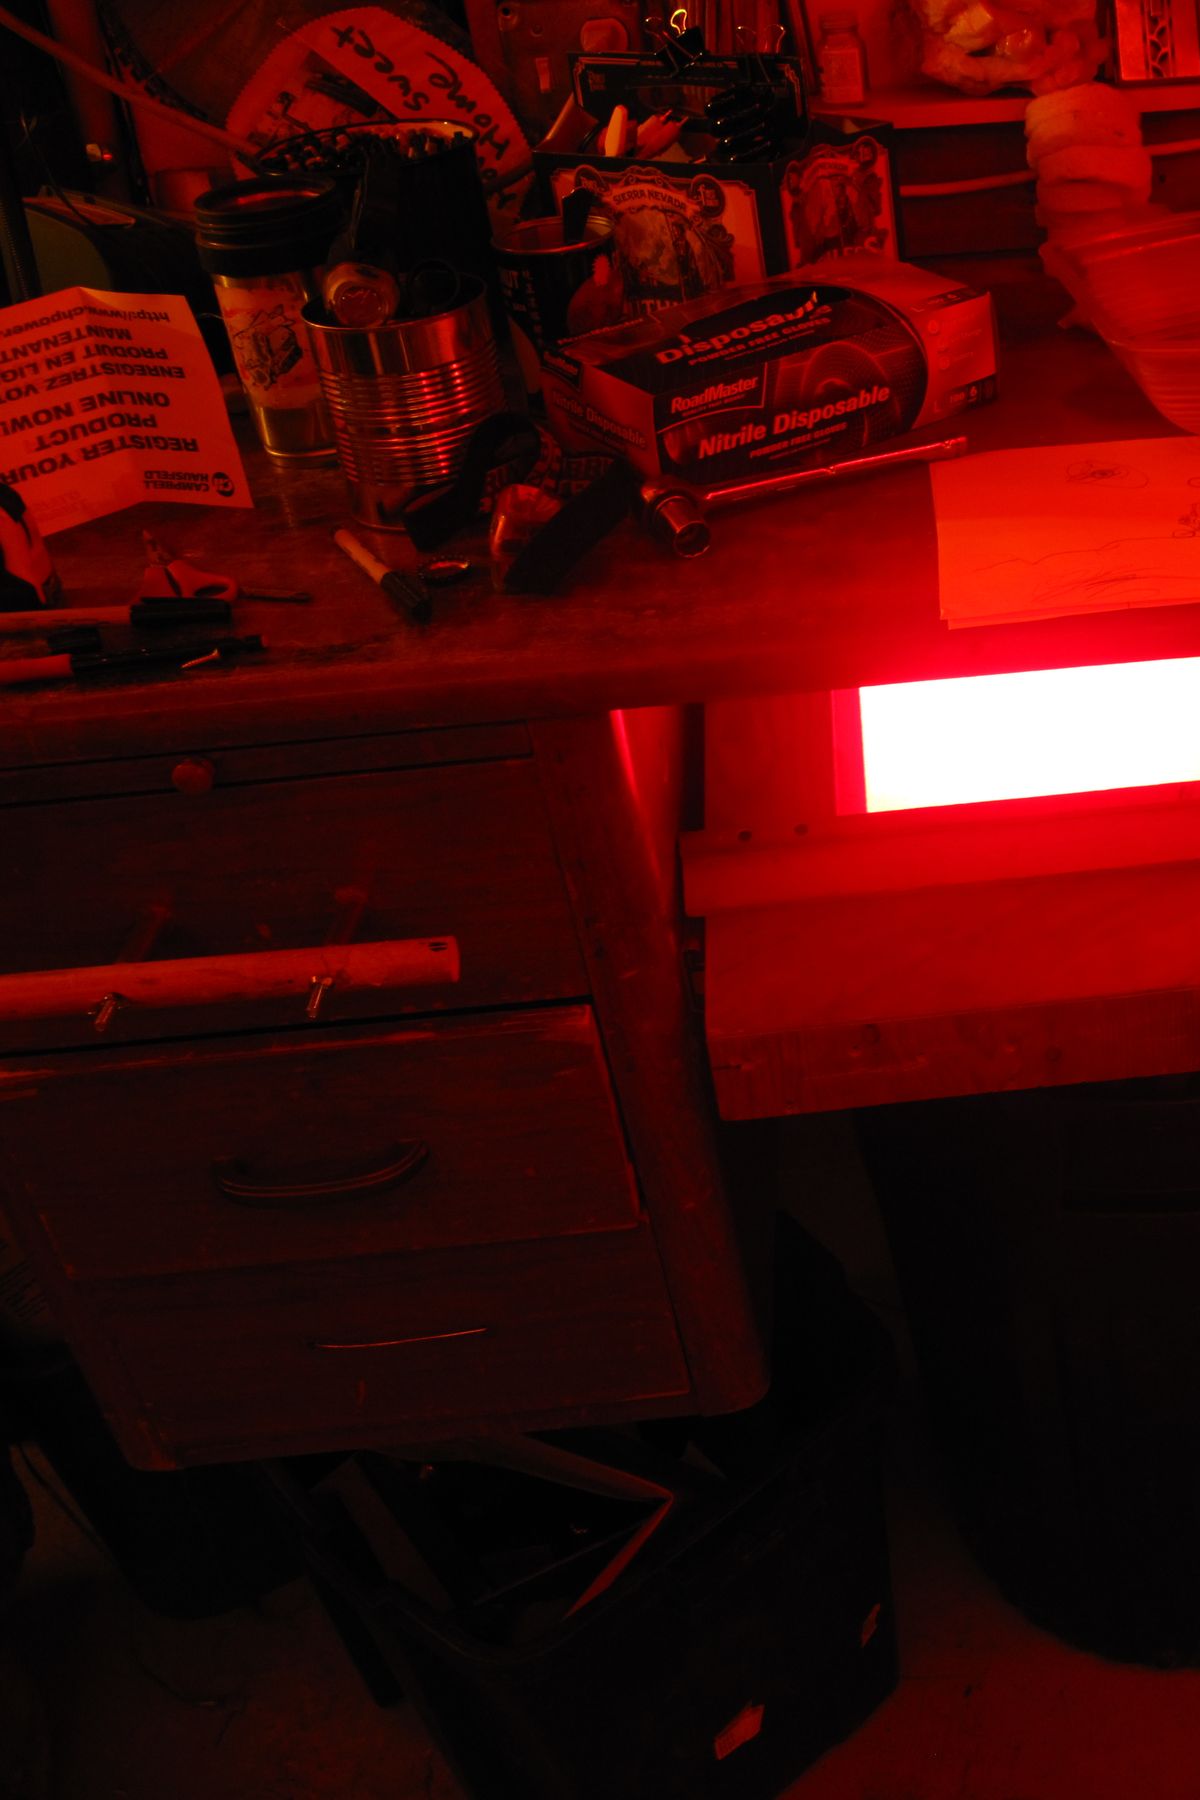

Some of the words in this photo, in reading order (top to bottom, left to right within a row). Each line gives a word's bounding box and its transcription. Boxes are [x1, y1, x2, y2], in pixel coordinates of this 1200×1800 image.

[612, 190, 648, 206] SIERRA
[647, 190, 687, 210] NEVADA
[655, 290, 832, 365] Disposae
[46, 351, 75, 370] EN
[83, 345, 168, 359] PRODUIT
[47, 362, 186, 391] ENREGISTREZ
[80, 392, 170, 412] ONLINE
[671, 376, 758, 414] RoadMaster
[34, 413, 158, 451] PRODUCT
[699, 422, 768, 460] Nitrile
[772, 385, 891, 435] Disposable
[80, 434, 198, 462] REGISTER
[0, 453, 76, 485] YOUR
[144, 470, 209, 481] HAUSFELD
[144, 480, 210, 492] CAMPBELL
